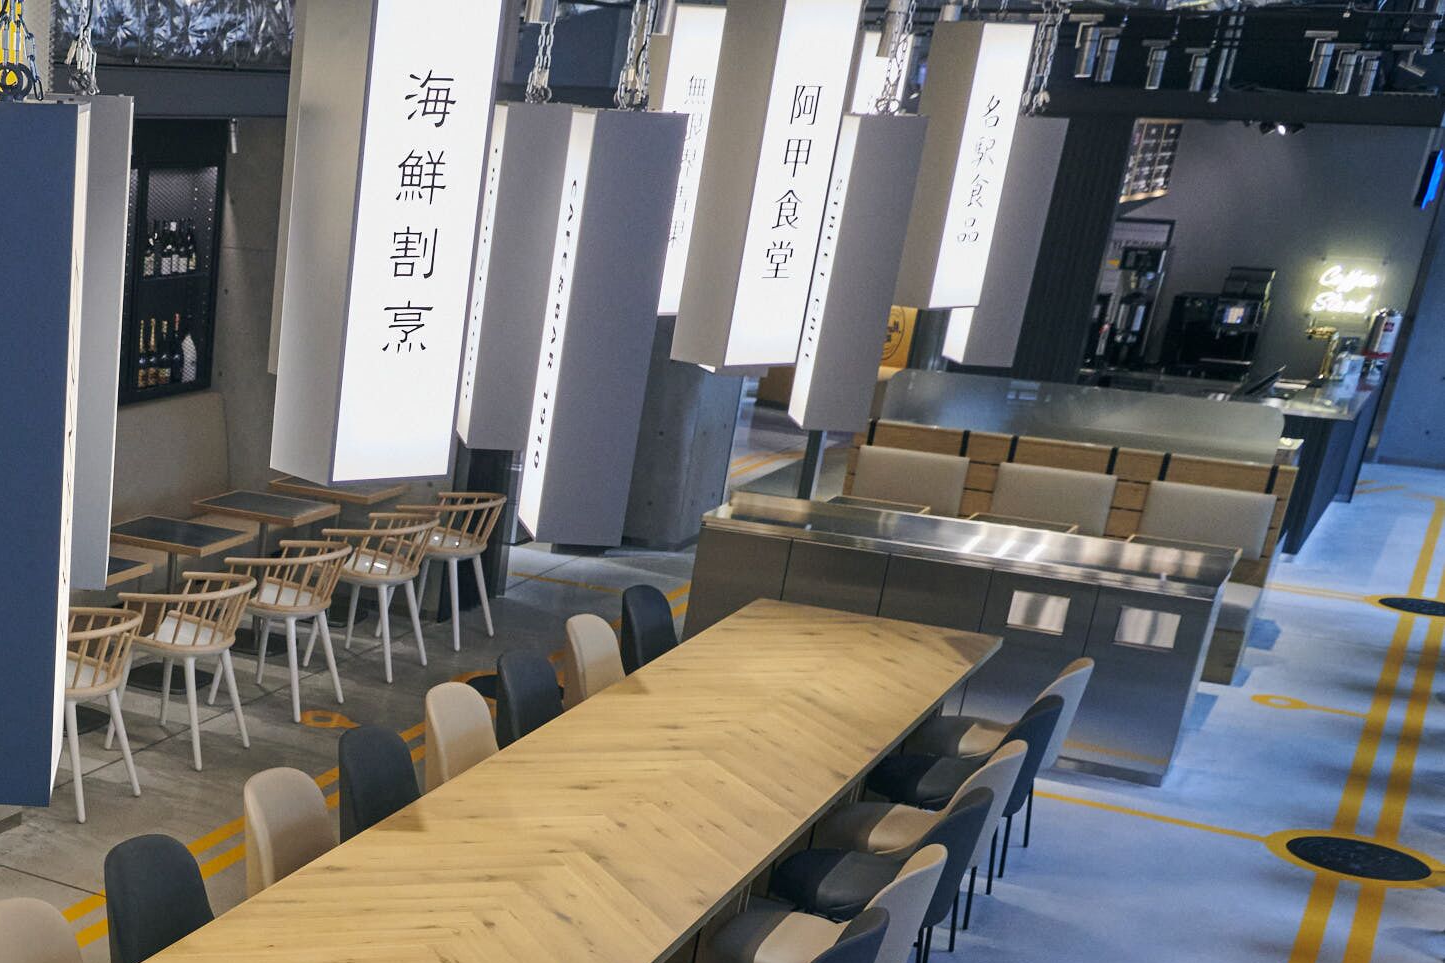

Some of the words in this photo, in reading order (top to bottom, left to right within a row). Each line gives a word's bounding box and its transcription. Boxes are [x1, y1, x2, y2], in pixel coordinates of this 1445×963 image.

[382, 69, 456, 353] 海鮮割烹
[761, 85, 824, 279] 阿甲食堂
